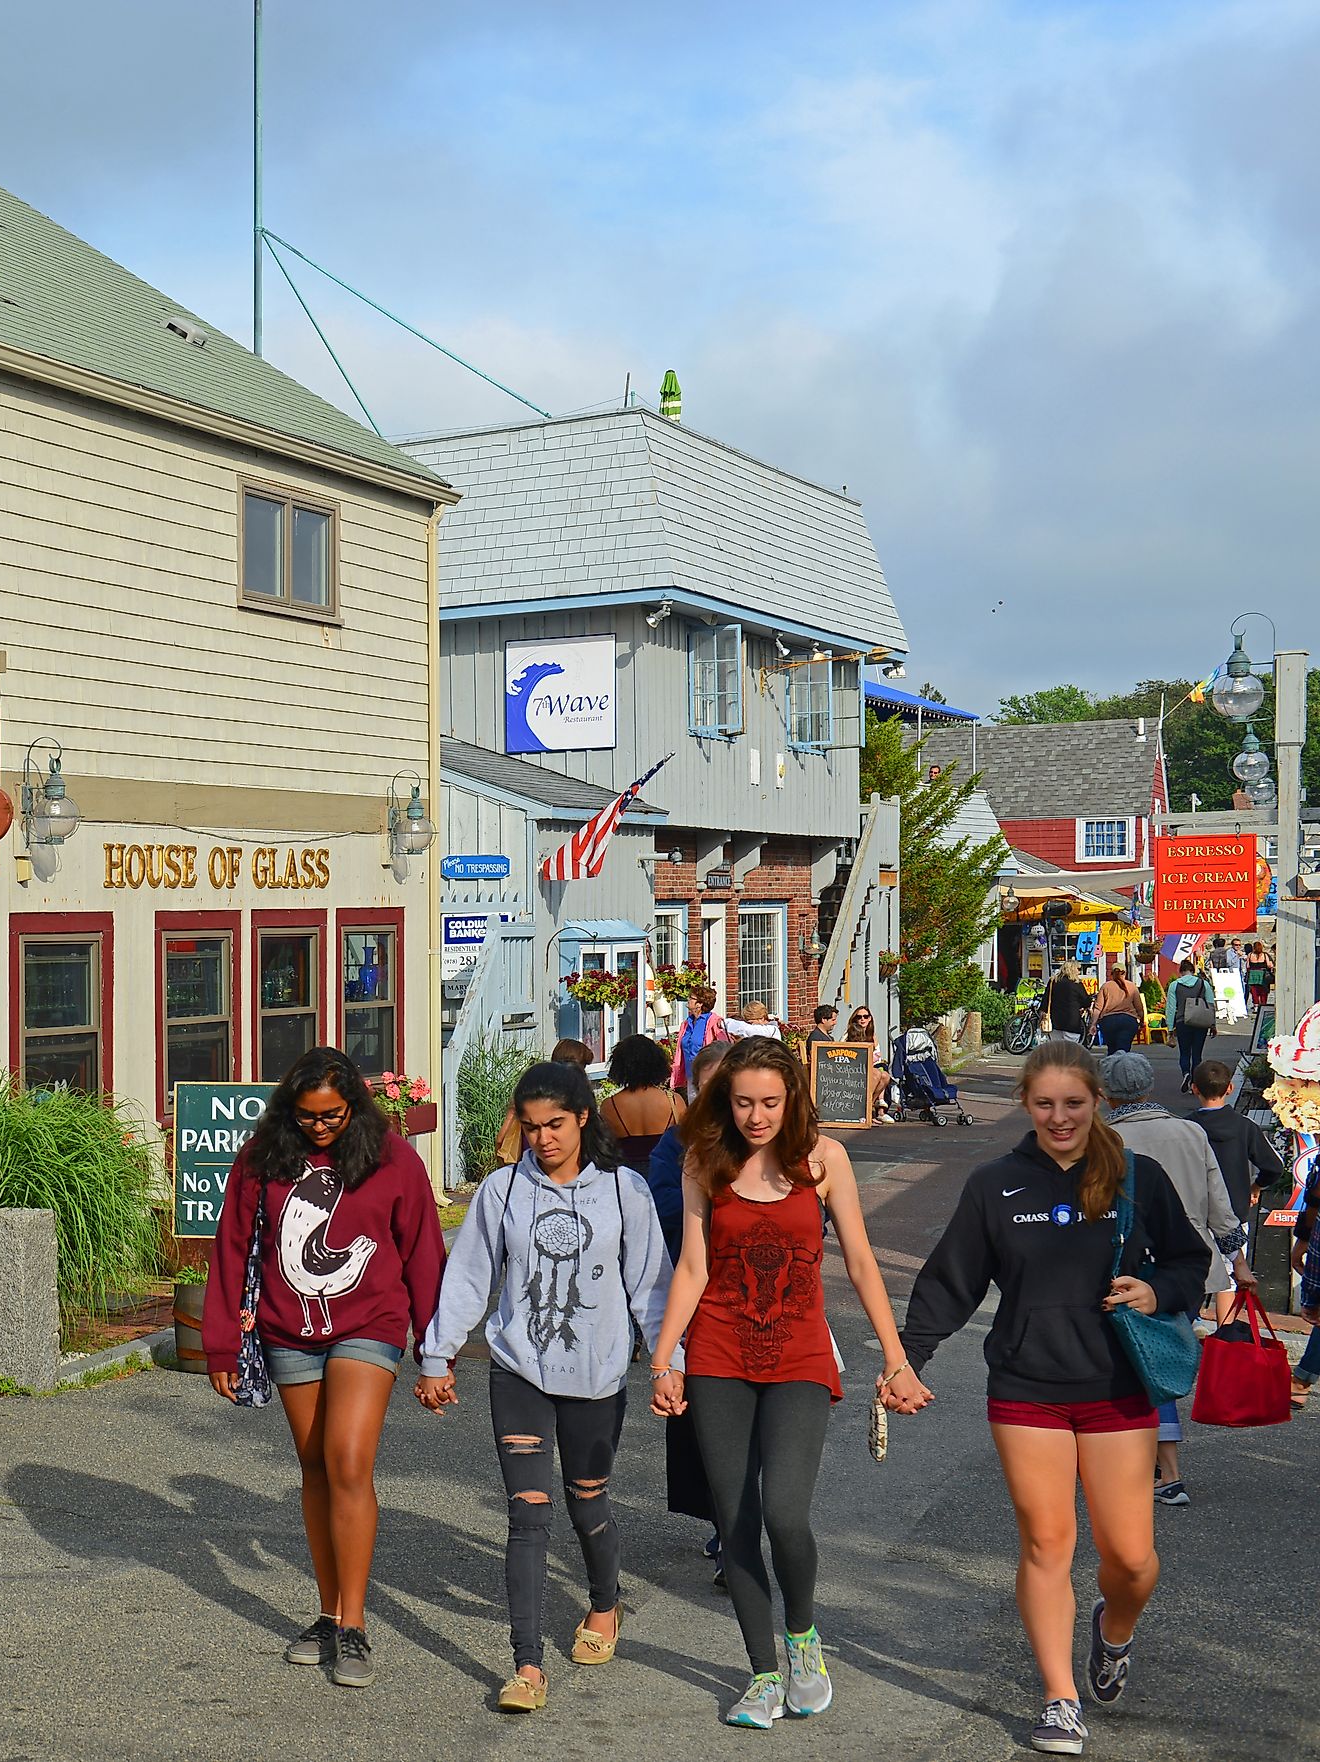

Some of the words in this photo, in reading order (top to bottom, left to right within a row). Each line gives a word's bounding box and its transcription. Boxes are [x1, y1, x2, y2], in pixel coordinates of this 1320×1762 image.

[544, 693, 609, 716] Wave
[564, 715, 603, 724] Restaurant
[1167, 844, 1244, 857] ESPRESSO
[103, 843, 198, 889] HOUSE
[208, 846, 243, 889] OF
[252, 847, 330, 889] GLASS
[455, 863, 464, 873] NO
[466, 863, 508, 873] TRESPASSING
[1161, 873, 1188, 884] ICE
[1193, 871, 1249, 883] CREAM
[1163, 898, 1249, 910] ELEPHANT
[1186, 912, 1225, 923] EARS
[827, 1049, 858, 1060] HARPOON
[834, 1056, 850, 1064] IPA
[211, 1096, 267, 1121] NO
[183, 1171, 211, 1193] No
[1012, 1212, 1049, 1223] CMASS
